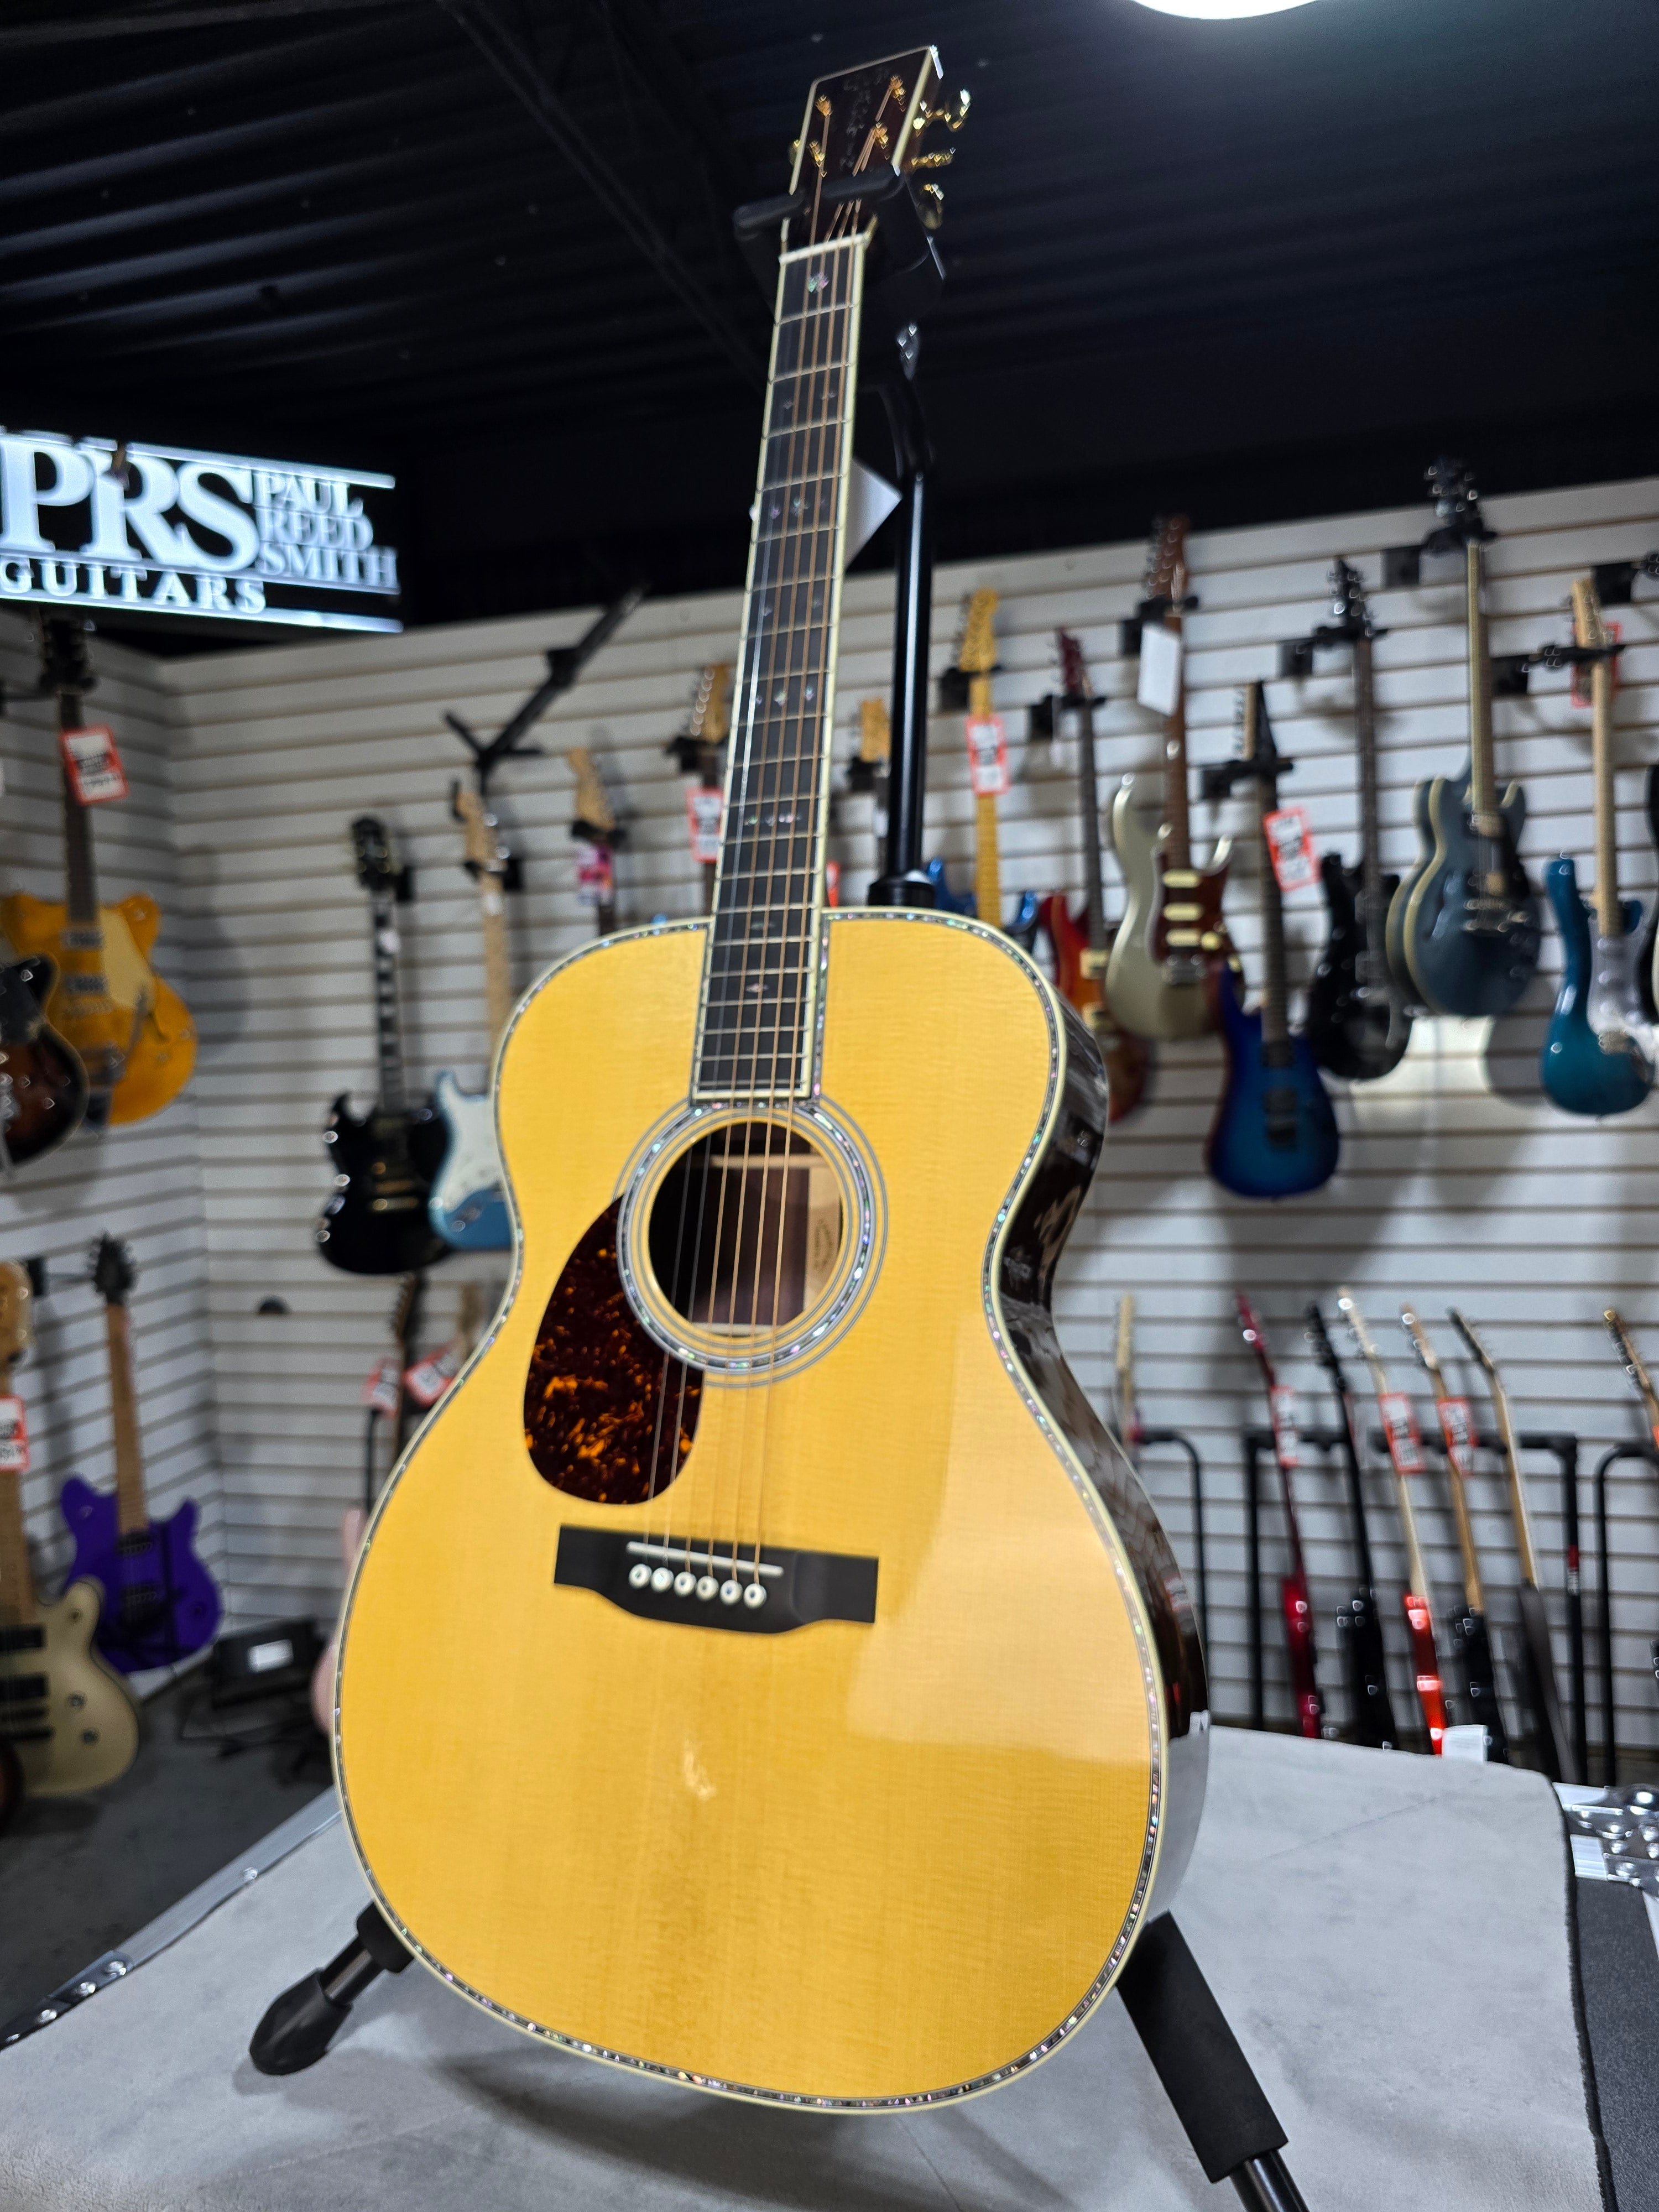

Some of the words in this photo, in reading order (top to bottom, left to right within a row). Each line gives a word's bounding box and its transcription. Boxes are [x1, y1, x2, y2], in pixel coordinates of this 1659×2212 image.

[0, 438, 260, 572] PRS
[253, 472, 363, 519] PAUL
[255, 507, 373, 551] REED
[0, 553, 265, 613] GUITARS
[258, 542, 397, 588] SMITH
